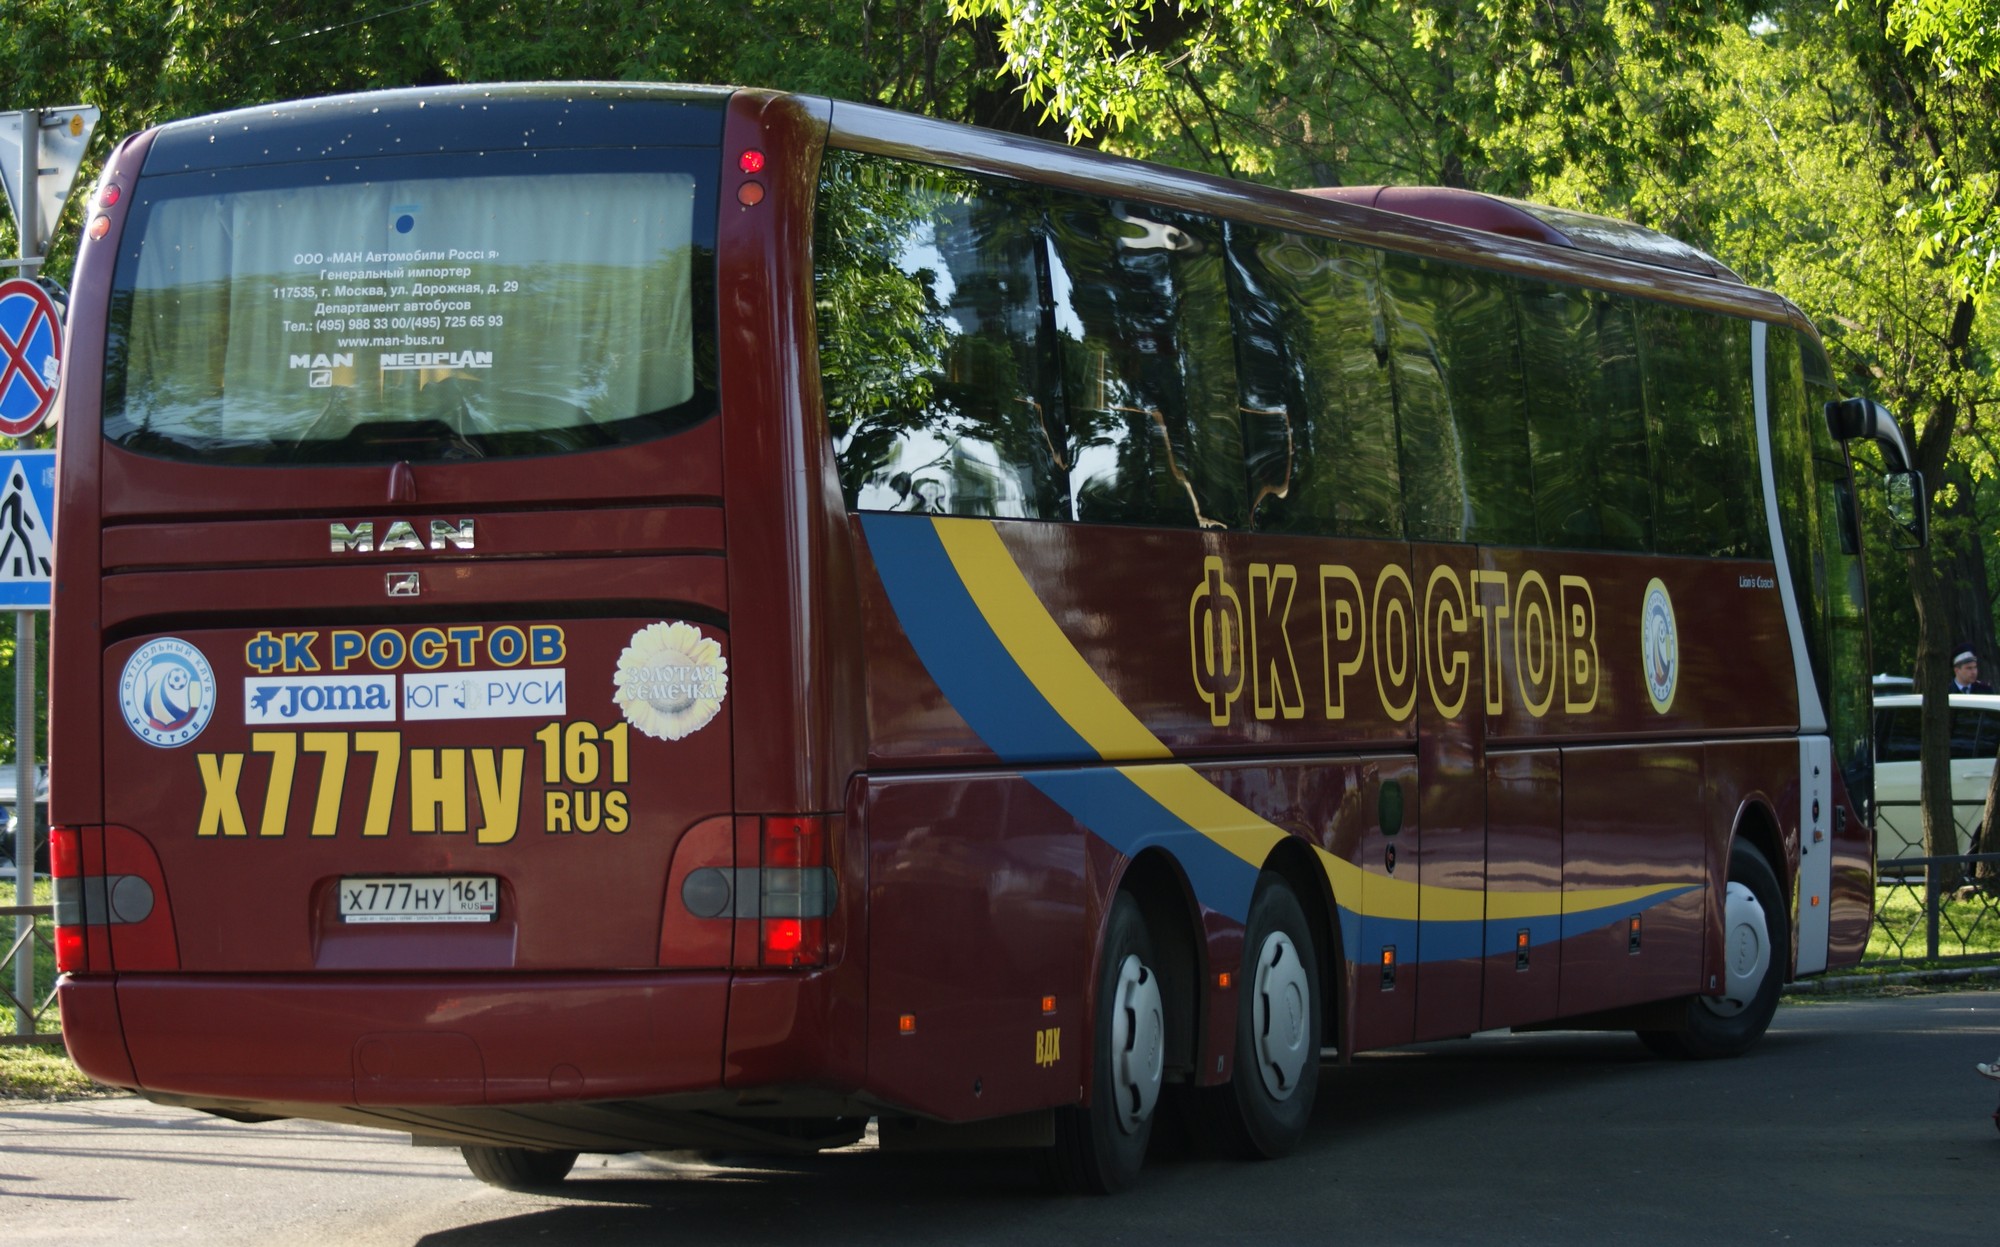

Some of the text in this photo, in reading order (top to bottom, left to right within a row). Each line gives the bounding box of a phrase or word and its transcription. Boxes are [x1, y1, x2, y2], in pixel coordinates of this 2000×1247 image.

[294, 254, 323, 265] ООО
[366, 250, 445, 263] Автомобили
[320, 266, 471, 281] Генеральный импортер
[273, 287, 318, 300] 117535,
[334, 286, 387, 298] Москва,
[390, 286, 409, 297] ул.
[412, 282, 484, 296] Дорожная,
[503, 281, 518, 292] 29
[315, 300, 471, 317] Департамент автобусов
[283, 321, 313, 332] Тел.:
[316, 319, 345, 333] (495)
[348, 318, 370, 330] 988
[373, 318, 388, 330] 33
[444, 316, 466, 328] 725
[470, 316, 484, 328] 65
[488, 315, 503, 327] 93
[338, 335, 445, 349] www.man-bus.ru
[290, 350, 493, 369] MAN NEOPLAN
[330, 519, 475, 553] MAN
[245, 625, 566, 673] ФК РОСТОВ
[1190, 555, 1600, 727] ФК РОСТОВ
[406, 680, 563, 708] ЮГ РУСИ
[133, 717, 200, 742] РОСТОВ
[536, 721, 630, 785] 161
[545, 790, 631, 835] RUS
[452, 880, 488, 901] 161
[461, 902, 480, 910] RUS
[1036, 1027, 1061, 1068] ВДХ
